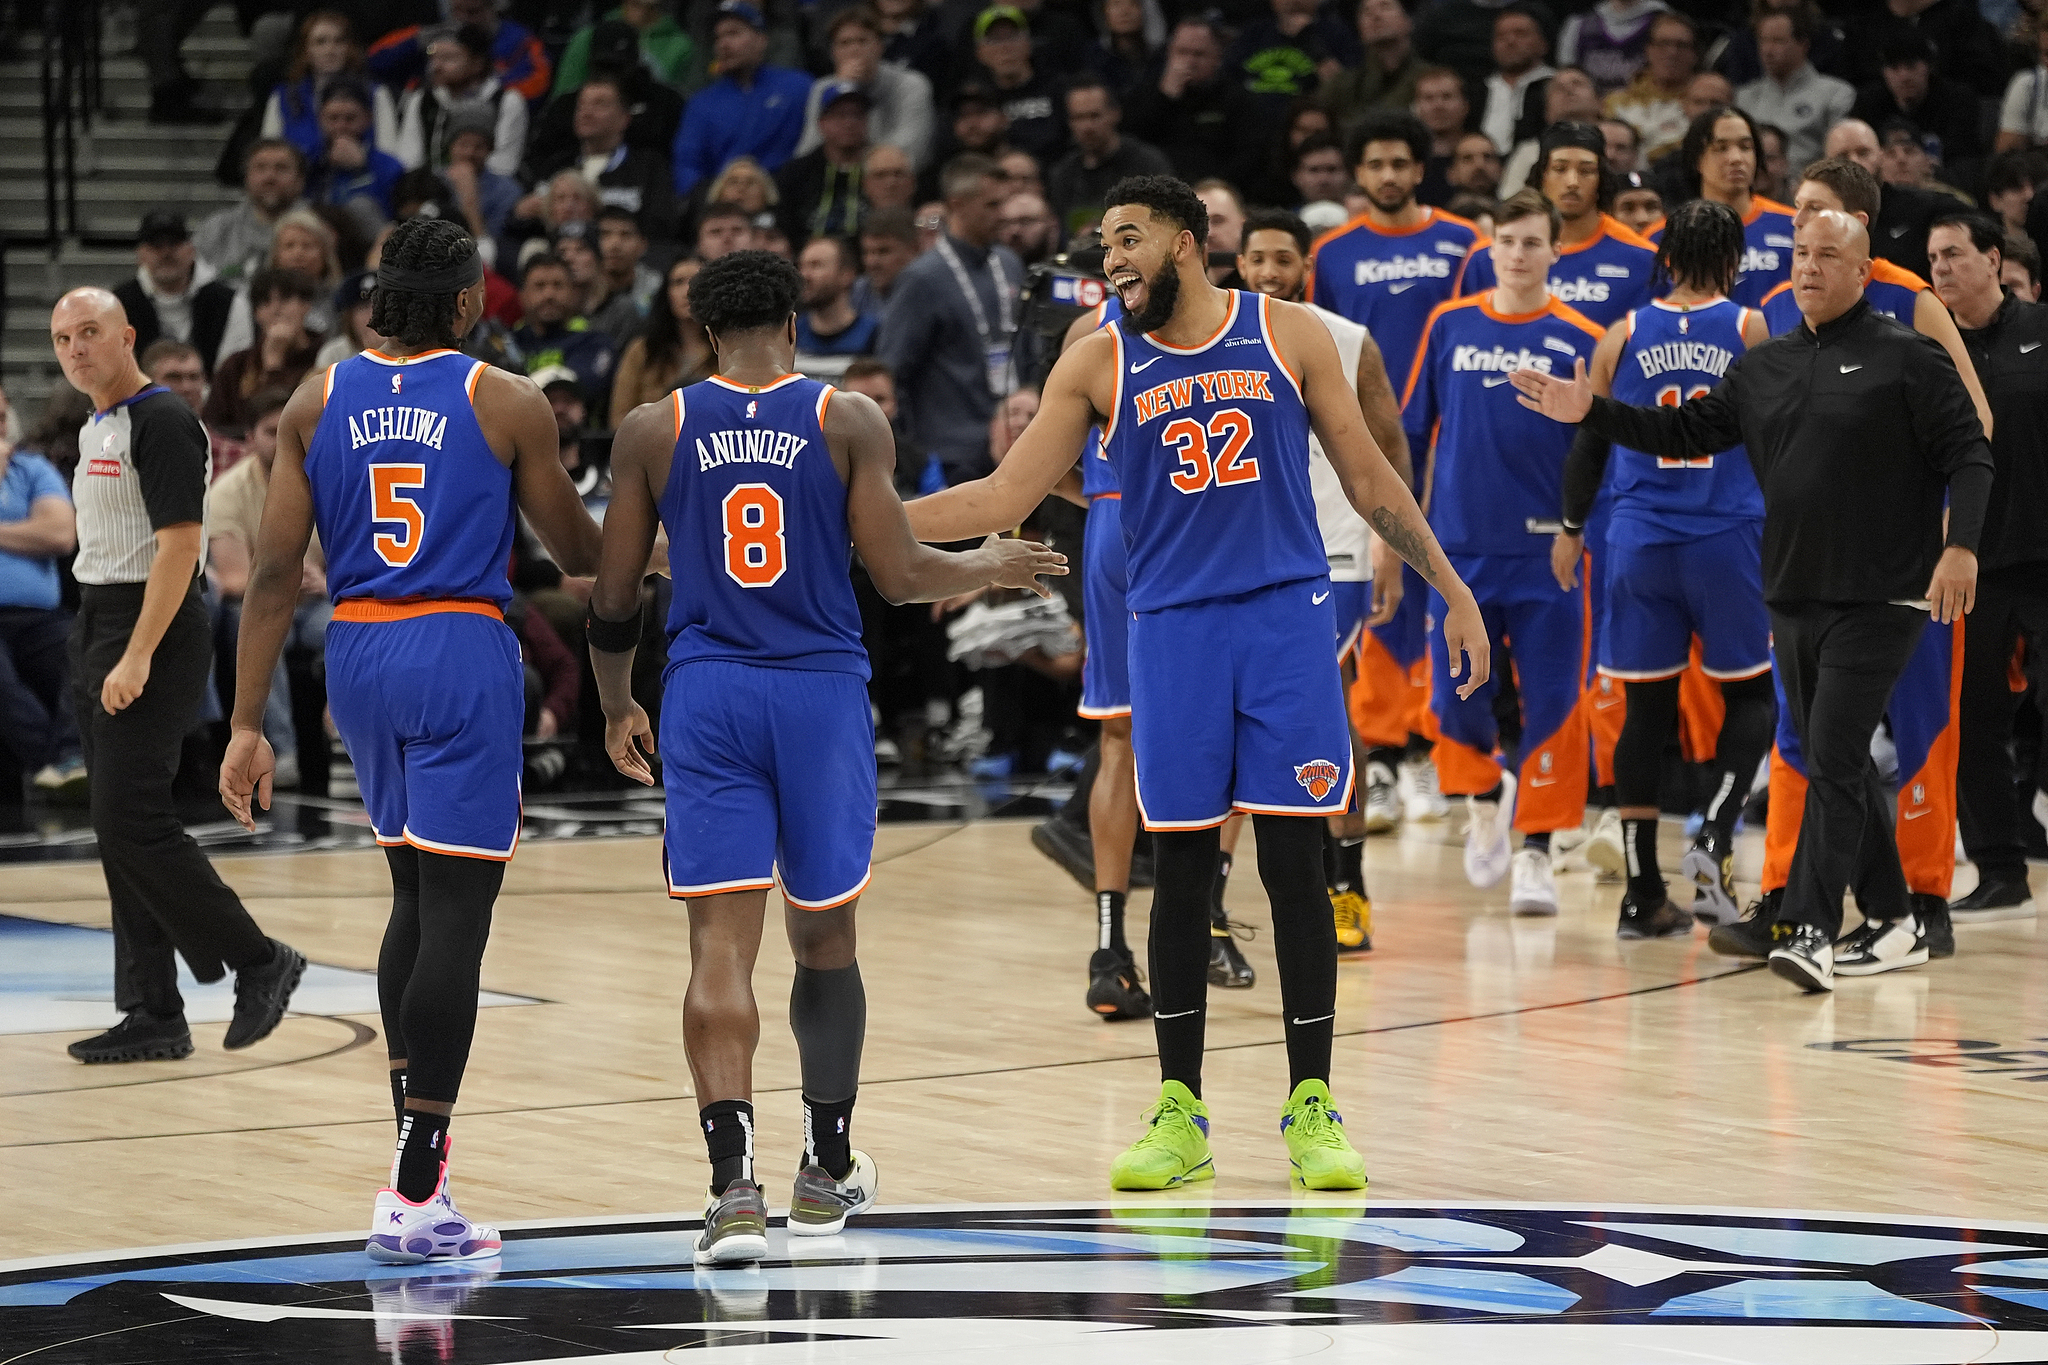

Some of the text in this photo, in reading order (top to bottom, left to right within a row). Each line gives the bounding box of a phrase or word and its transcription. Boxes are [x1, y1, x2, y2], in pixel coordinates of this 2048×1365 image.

[1355, 253, 1450, 286] Knicks
[1547, 276, 1611, 302] icks
[1453, 345, 1553, 374] Knicks
[1635, 341, 1734, 379] BRUNSON
[1133, 369, 1275, 428] NEW YORK
[348, 406, 448, 451] ACHIUWA
[88, 463, 120, 475] Emirates
[695, 429, 809, 473] ANUNOBY
[1161, 407, 1261, 495] 32
[368, 463, 426, 568] 5
[721, 482, 788, 589] 8
[1298, 764, 1338, 781] KNICKS
